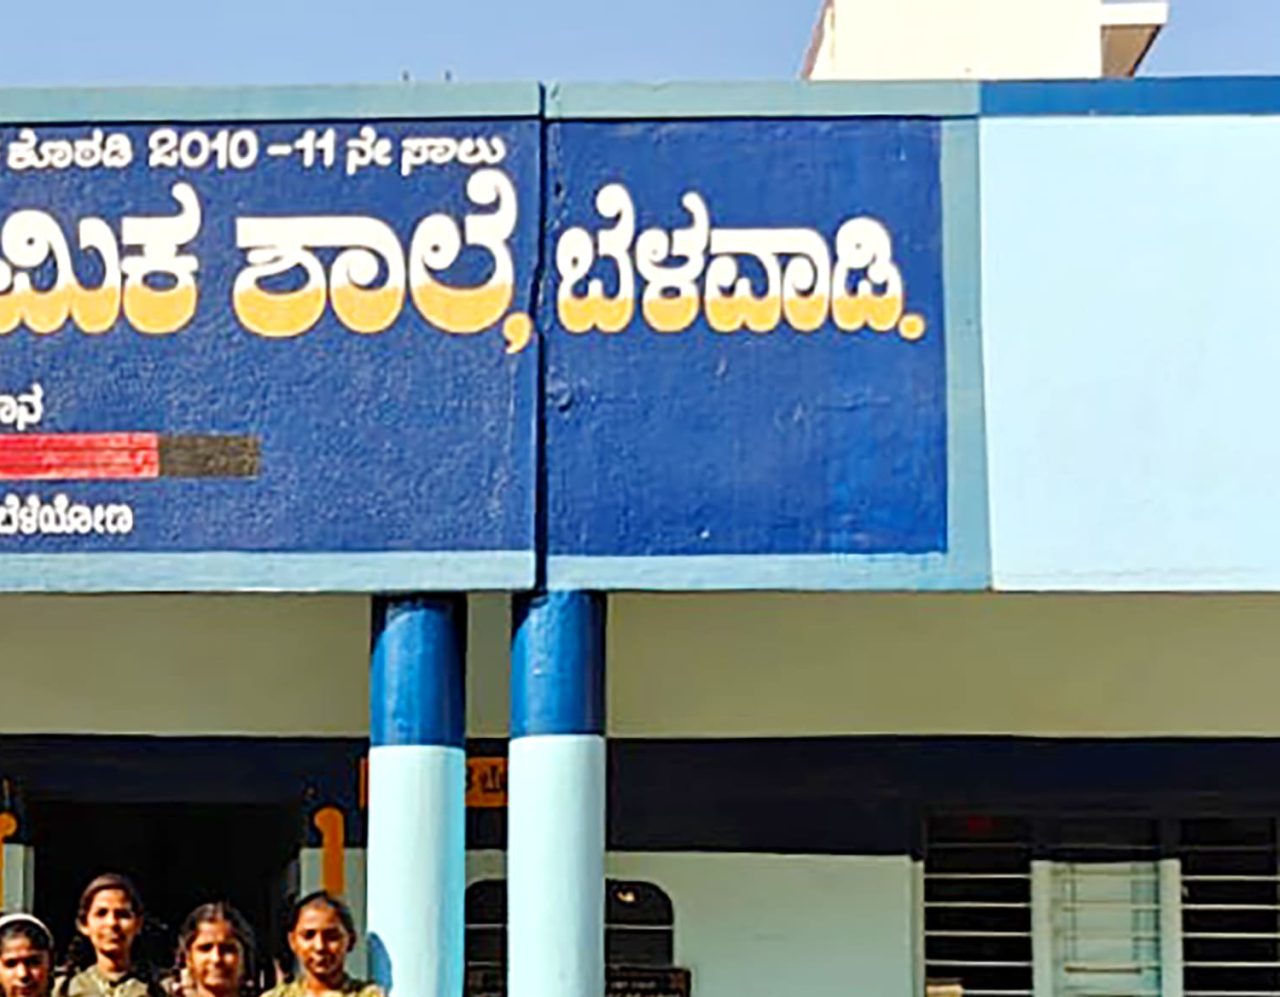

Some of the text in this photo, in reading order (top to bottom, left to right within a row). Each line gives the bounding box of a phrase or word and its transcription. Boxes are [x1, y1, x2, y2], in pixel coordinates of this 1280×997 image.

[7, 128, 133, 170] ಕೊಠಡಿ
[346, 126, 392, 175] ನೇ
[401, 136, 506, 176] ಸಾಲು
[233, 168, 532, 354] ಶಾಲೆ,
[556, 184, 925, 339] ಬೆಳವಾಡಿ.
